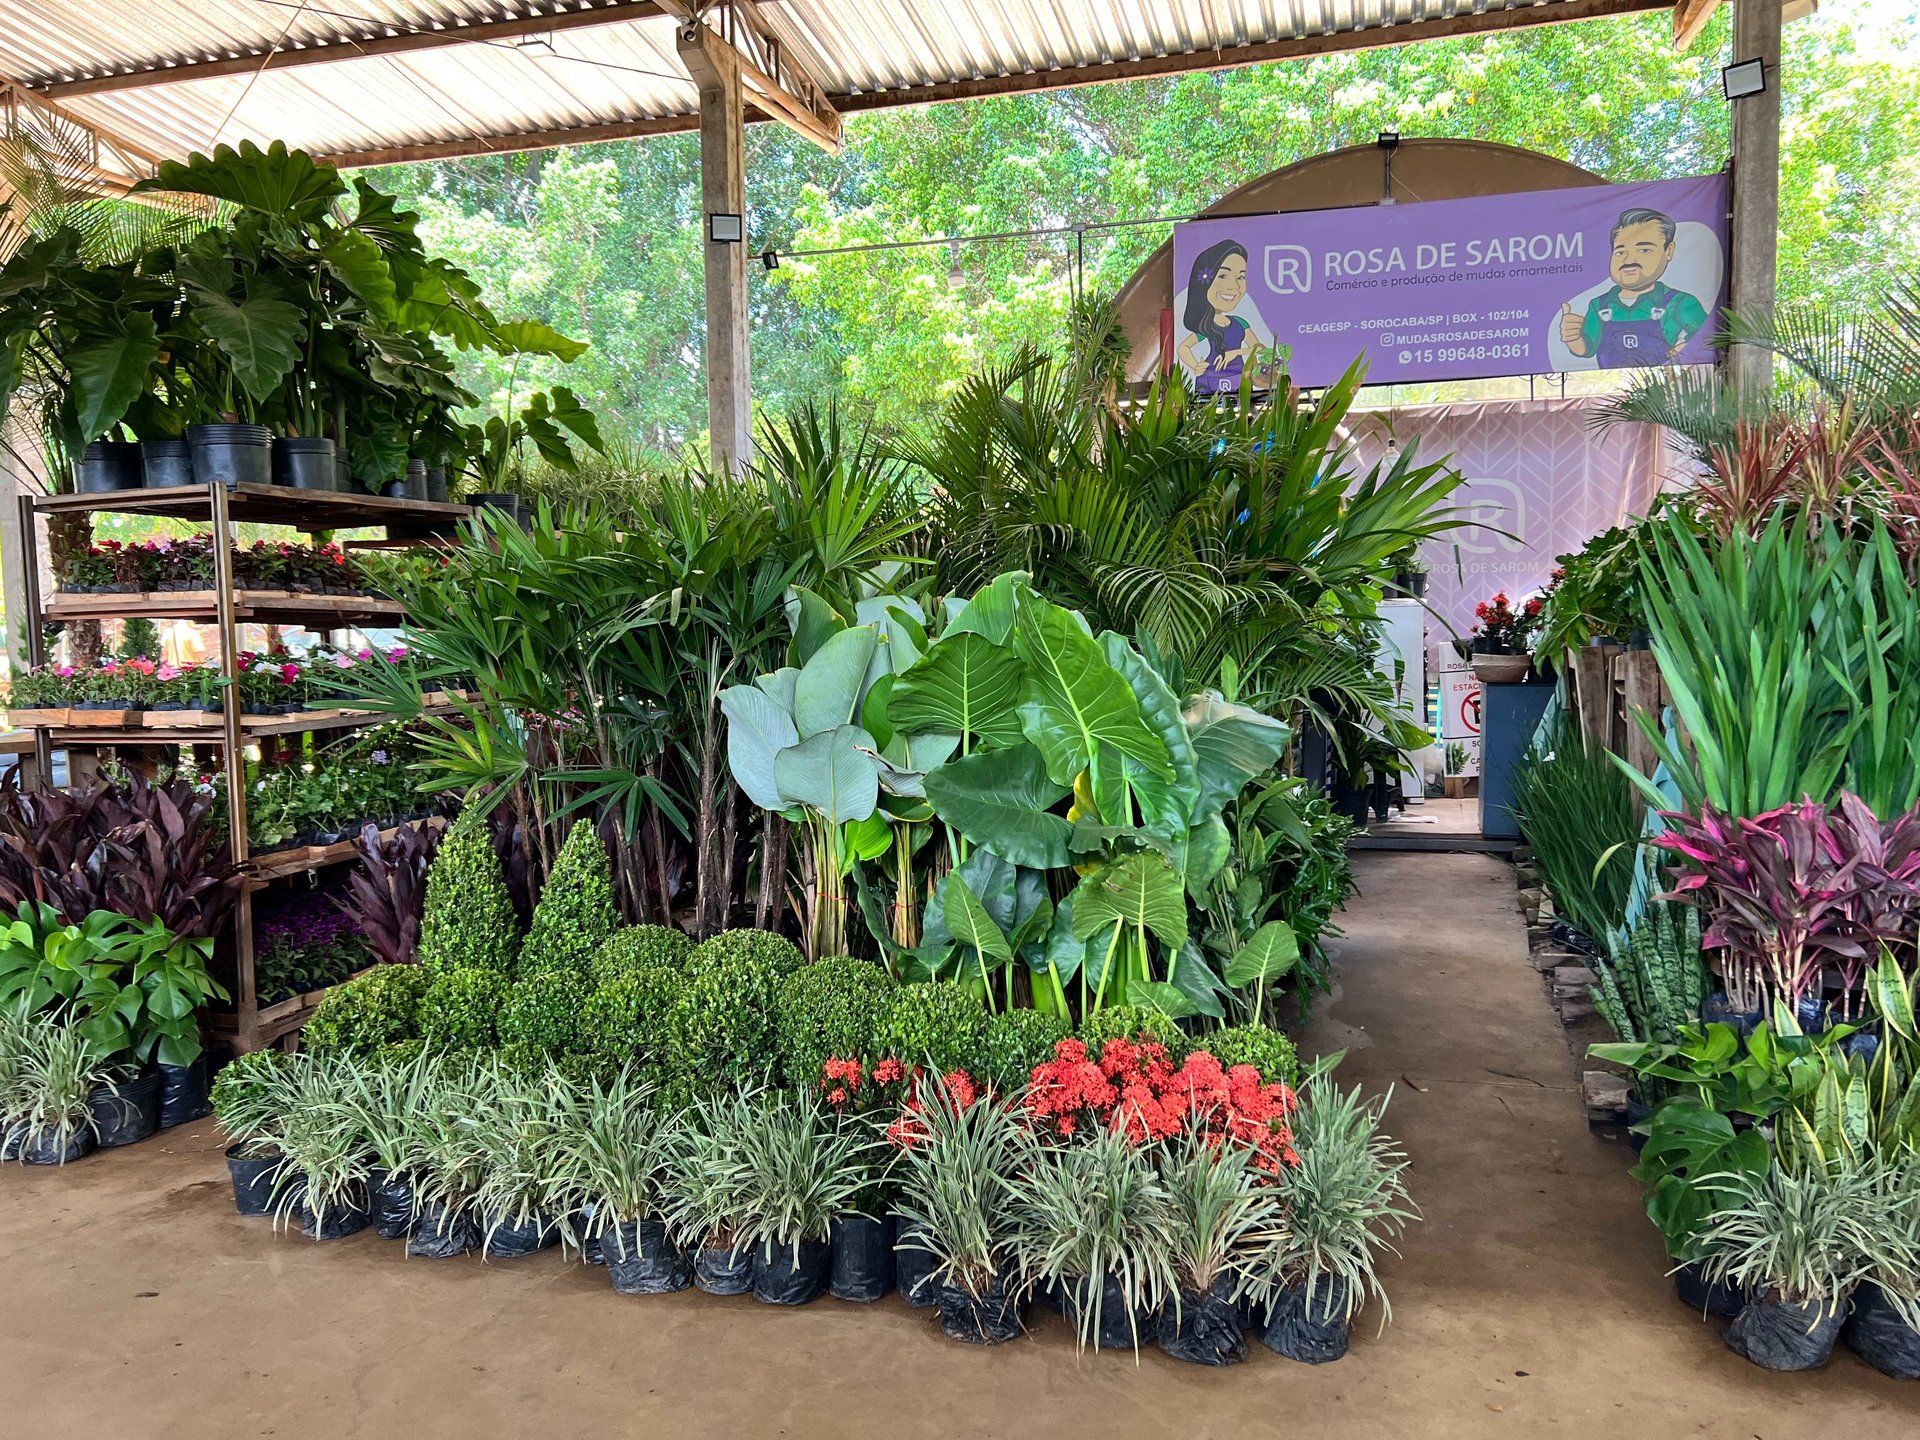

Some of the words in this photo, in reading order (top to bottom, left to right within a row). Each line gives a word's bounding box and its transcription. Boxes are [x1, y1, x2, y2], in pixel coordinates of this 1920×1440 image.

[1325, 247, 1407, 277] ROSA
[1416, 242, 1457, 270] DE
[1465, 232, 1583, 266] SAROM
[1326, 277, 1378, 291] Comércio
[1381, 278, 1388, 287] e
[1391, 273, 1446, 288] produção
[1448, 270, 1463, 283] de
[1466, 268, 1506, 281] mudas
[1508, 262, 1583, 277] ornamentais
[1298, 321, 1351, 334] CEAGESP
[1360, 315, 1443, 330] SOROCABA/SP
[1452, 313, 1478, 323] BOX
[1487, 309, 1529, 321] 102/104
[1396, 327, 1529, 345] MUDASROSADESAROM
[1414, 349, 1433, 363] 15
[1437, 343, 1529, 362] 99648-0361
[1432, 562, 1466, 574] ROSA
[1471, 563, 1488, 573] DE
[1491, 561, 1539, 573] SAROM
